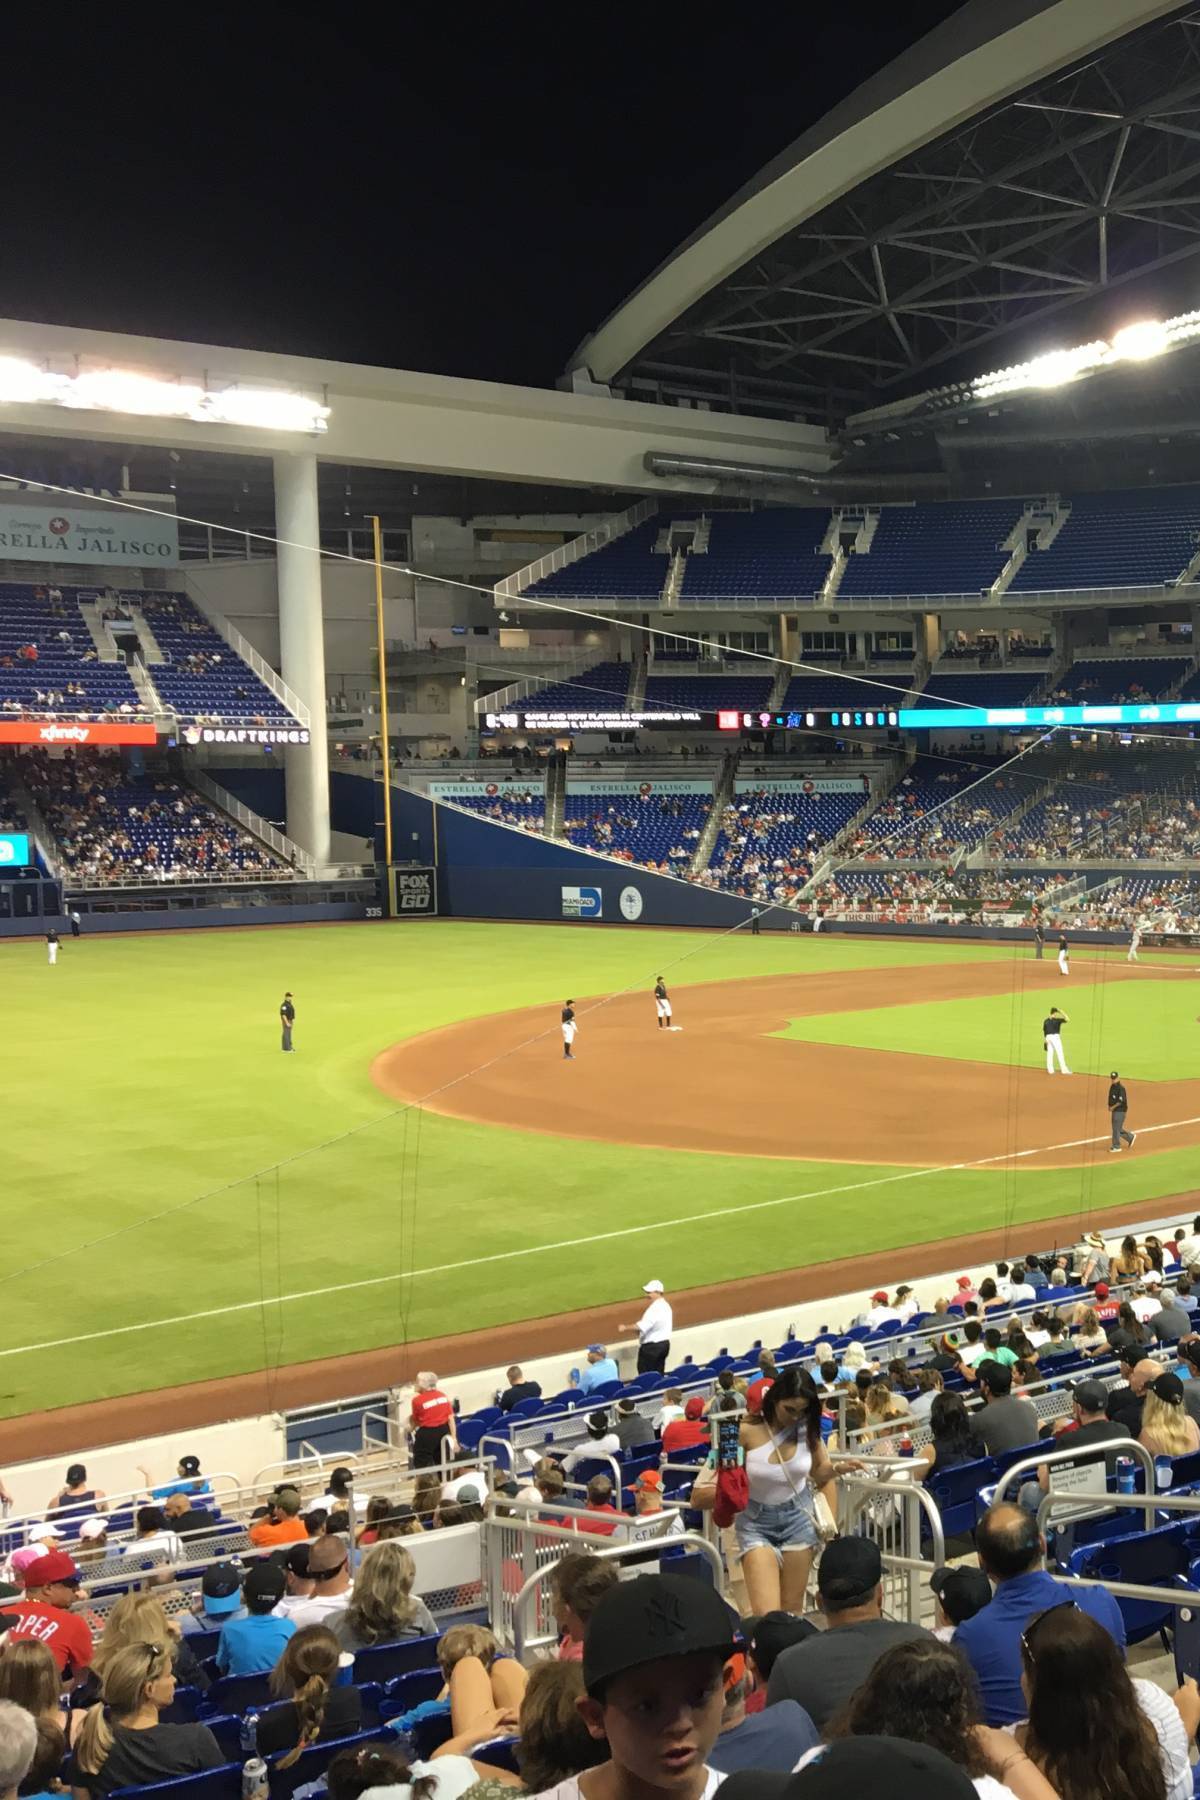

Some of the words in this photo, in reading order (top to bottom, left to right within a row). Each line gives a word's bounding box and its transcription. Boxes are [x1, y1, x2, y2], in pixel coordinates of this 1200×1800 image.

[78, 538, 172, 557] JALISCO
[549, 713, 567, 721] AND
[567, 713, 588, 721] NOW
[589, 713, 621, 721] PLAYING
[622, 713, 630, 721] IN
[682, 713, 701, 721] WILL
[40, 725, 89, 742] xfinity
[203, 729, 310, 743] DRAFTKINGS
[434, 785, 483, 793] ESTRELLA
[499, 784, 540, 793] JALISCO
[590, 784, 637, 792] ESTRELLA
[756, 783, 800, 791] ESTRELLA
[400, 874, 430, 888] FOX
[401, 894, 430, 908] GO
[845, 914, 865, 922] THIS
